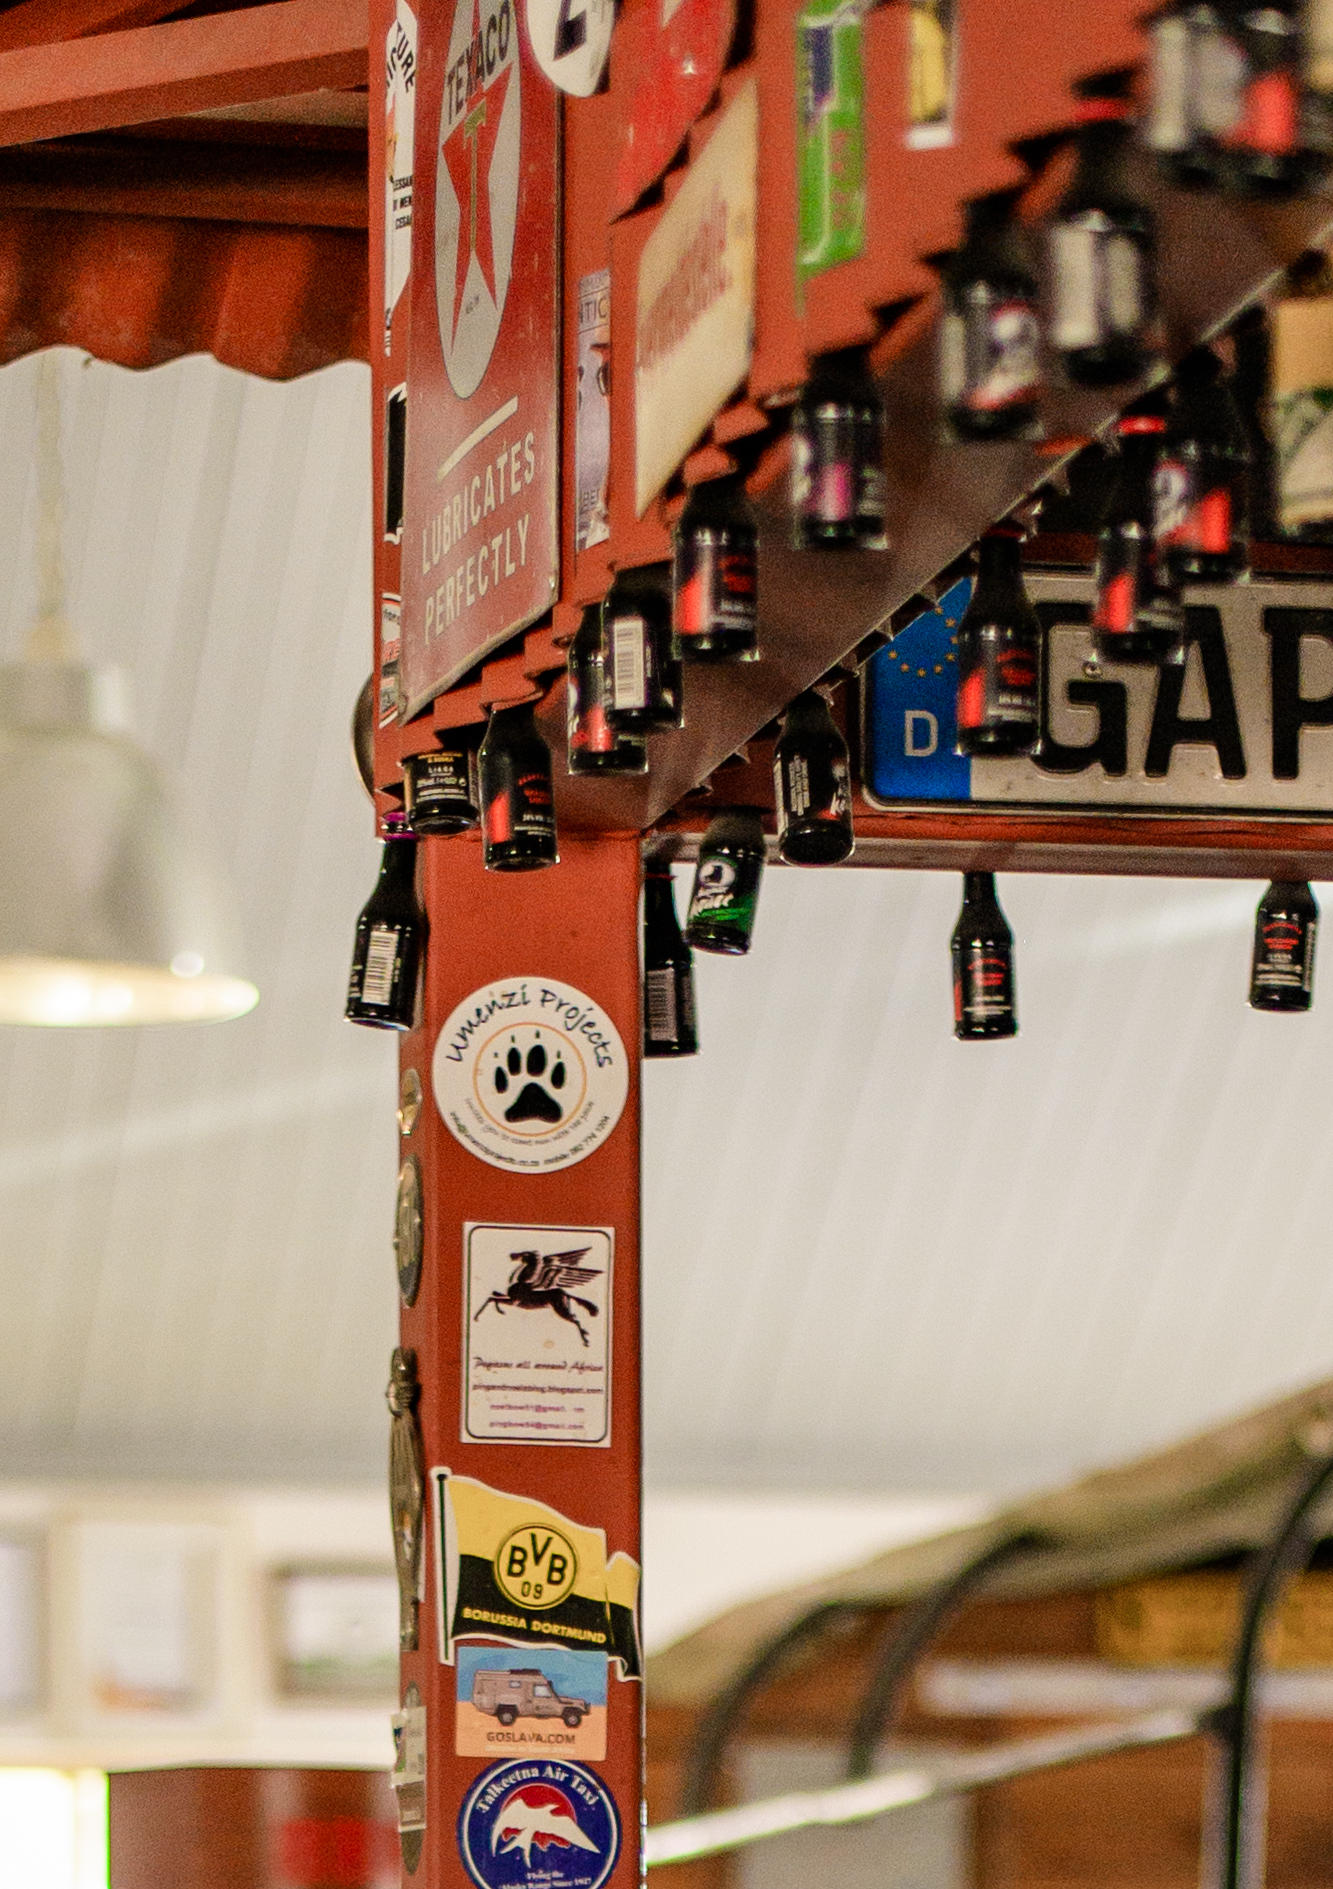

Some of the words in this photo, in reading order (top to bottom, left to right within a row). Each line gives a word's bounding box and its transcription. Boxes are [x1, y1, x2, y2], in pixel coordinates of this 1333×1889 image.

[448, 0, 511, 125] TEXACO
[421, 430, 536, 576] LUBRICATES
[424, 513, 531, 645] PERFECTLY
[904, 709, 939, 757] D
[539, 988, 613, 1068] Projects
[507, 1533, 568, 1586] BVB
[521, 1581, 544, 1600] 09
[462, 1607, 528, 1630] BORUSSIA
[531, 1619, 607, 1644] DORTMUND
[476, 1766, 540, 1813] Talkeetna
[543, 1764, 569, 1781] Air
[570, 1774, 600, 1806] Taxi
